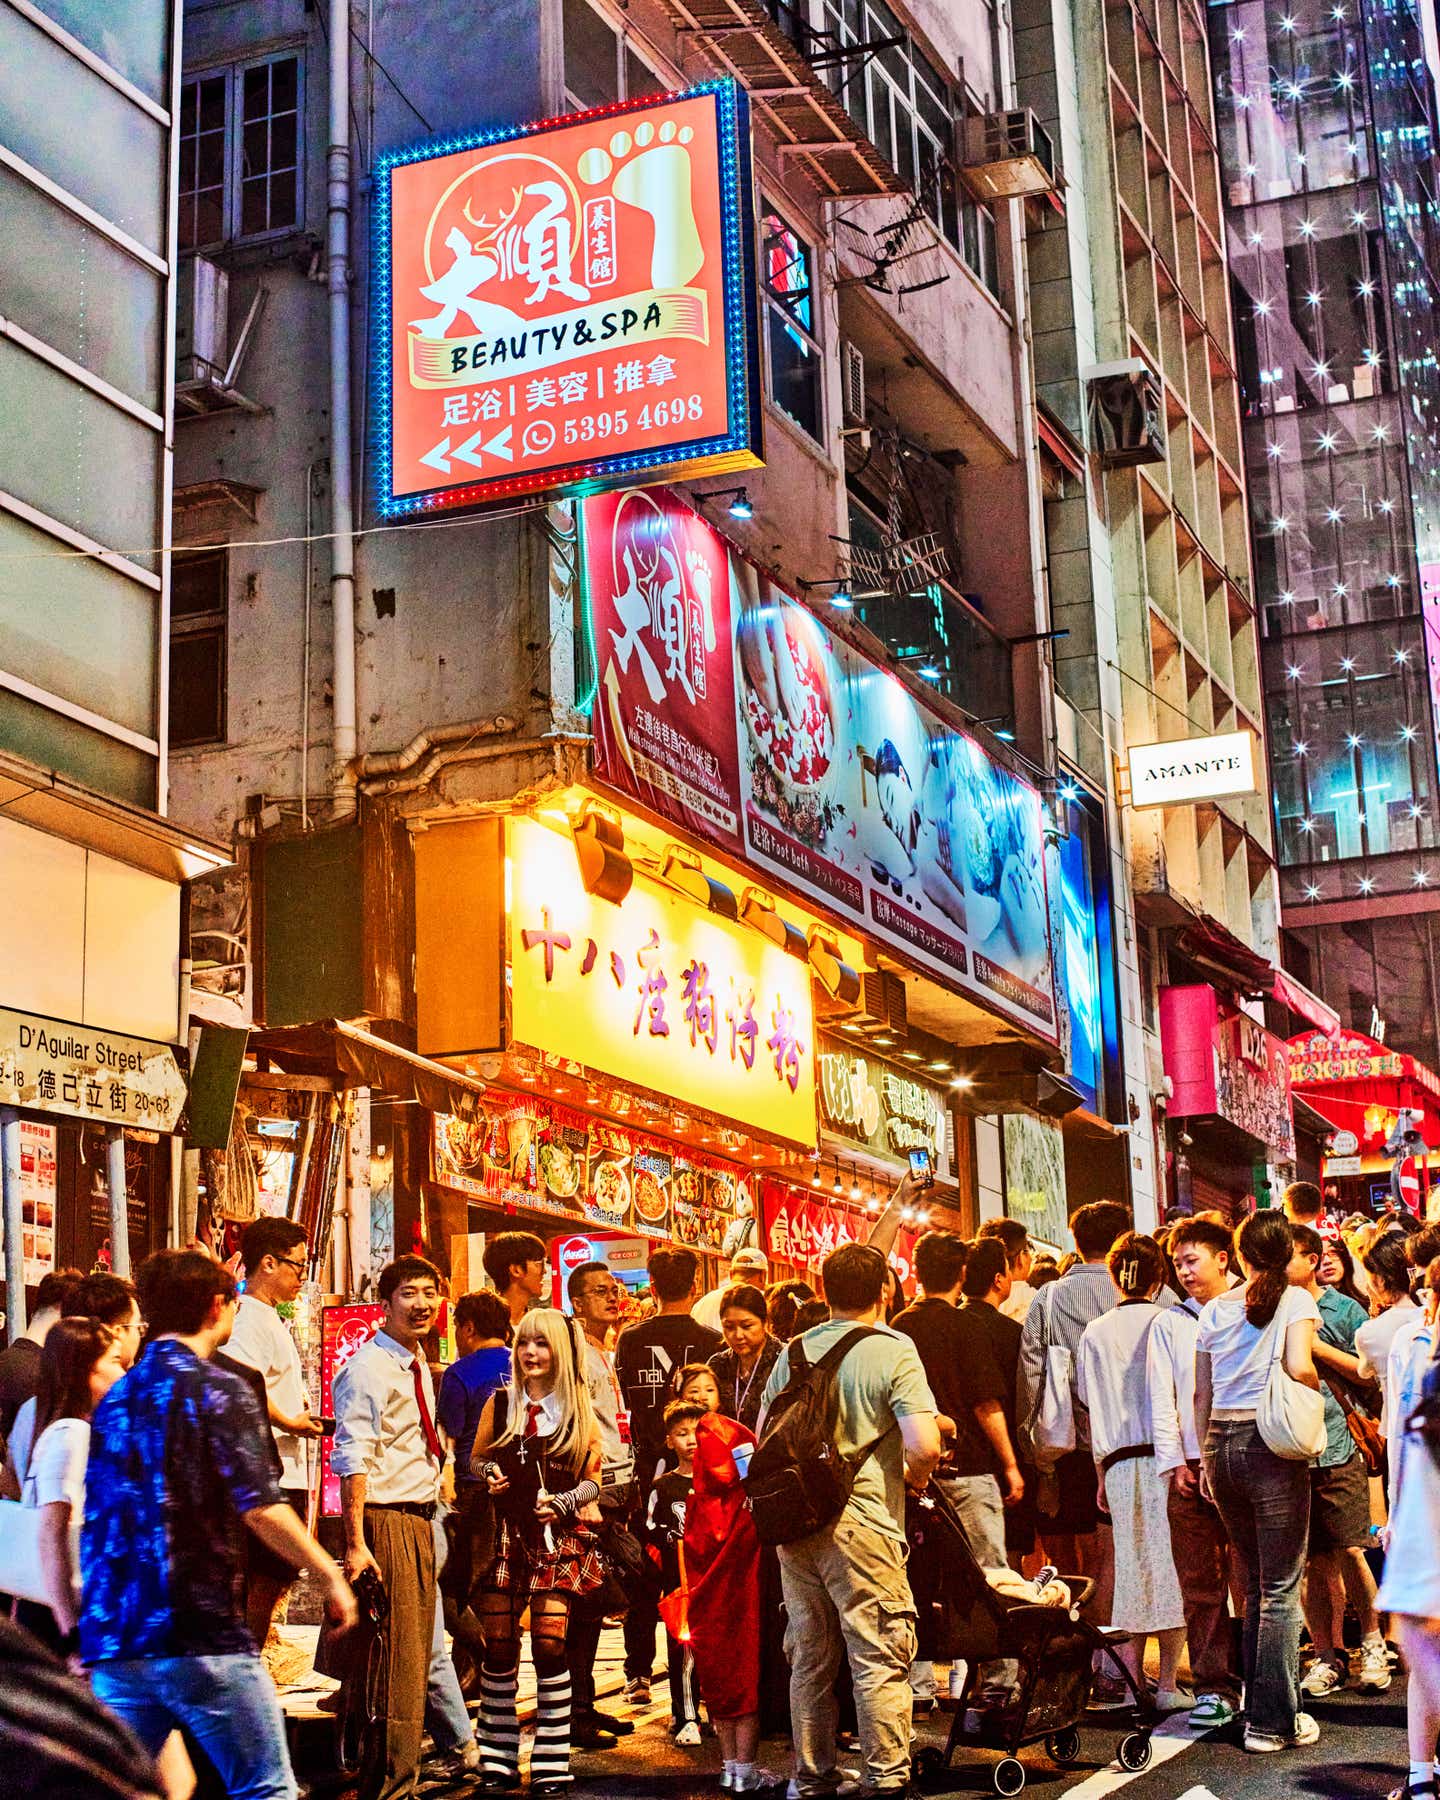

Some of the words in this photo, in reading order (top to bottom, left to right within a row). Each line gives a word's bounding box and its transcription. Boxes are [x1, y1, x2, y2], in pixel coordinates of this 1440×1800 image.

[589, 205, 612, 280] 養生館
[441, 389, 502, 428] 足浴
[526, 371, 589, 411] 美容
[614, 353, 677, 394] 推拿
[564, 410, 628, 445] 5395
[637, 394, 703, 433] 4698
[1145, 757, 1240, 781] AMANTE
[771, 836, 790, 866] Foot
[792, 852, 810, 873] bath
[19, 1025, 89, 1061] D'Aguilar
[96, 1042, 143, 1072] Street
[38, 1069, 127, 1112] 德己立街
[135, 1093, 170, 1113] 20-62
